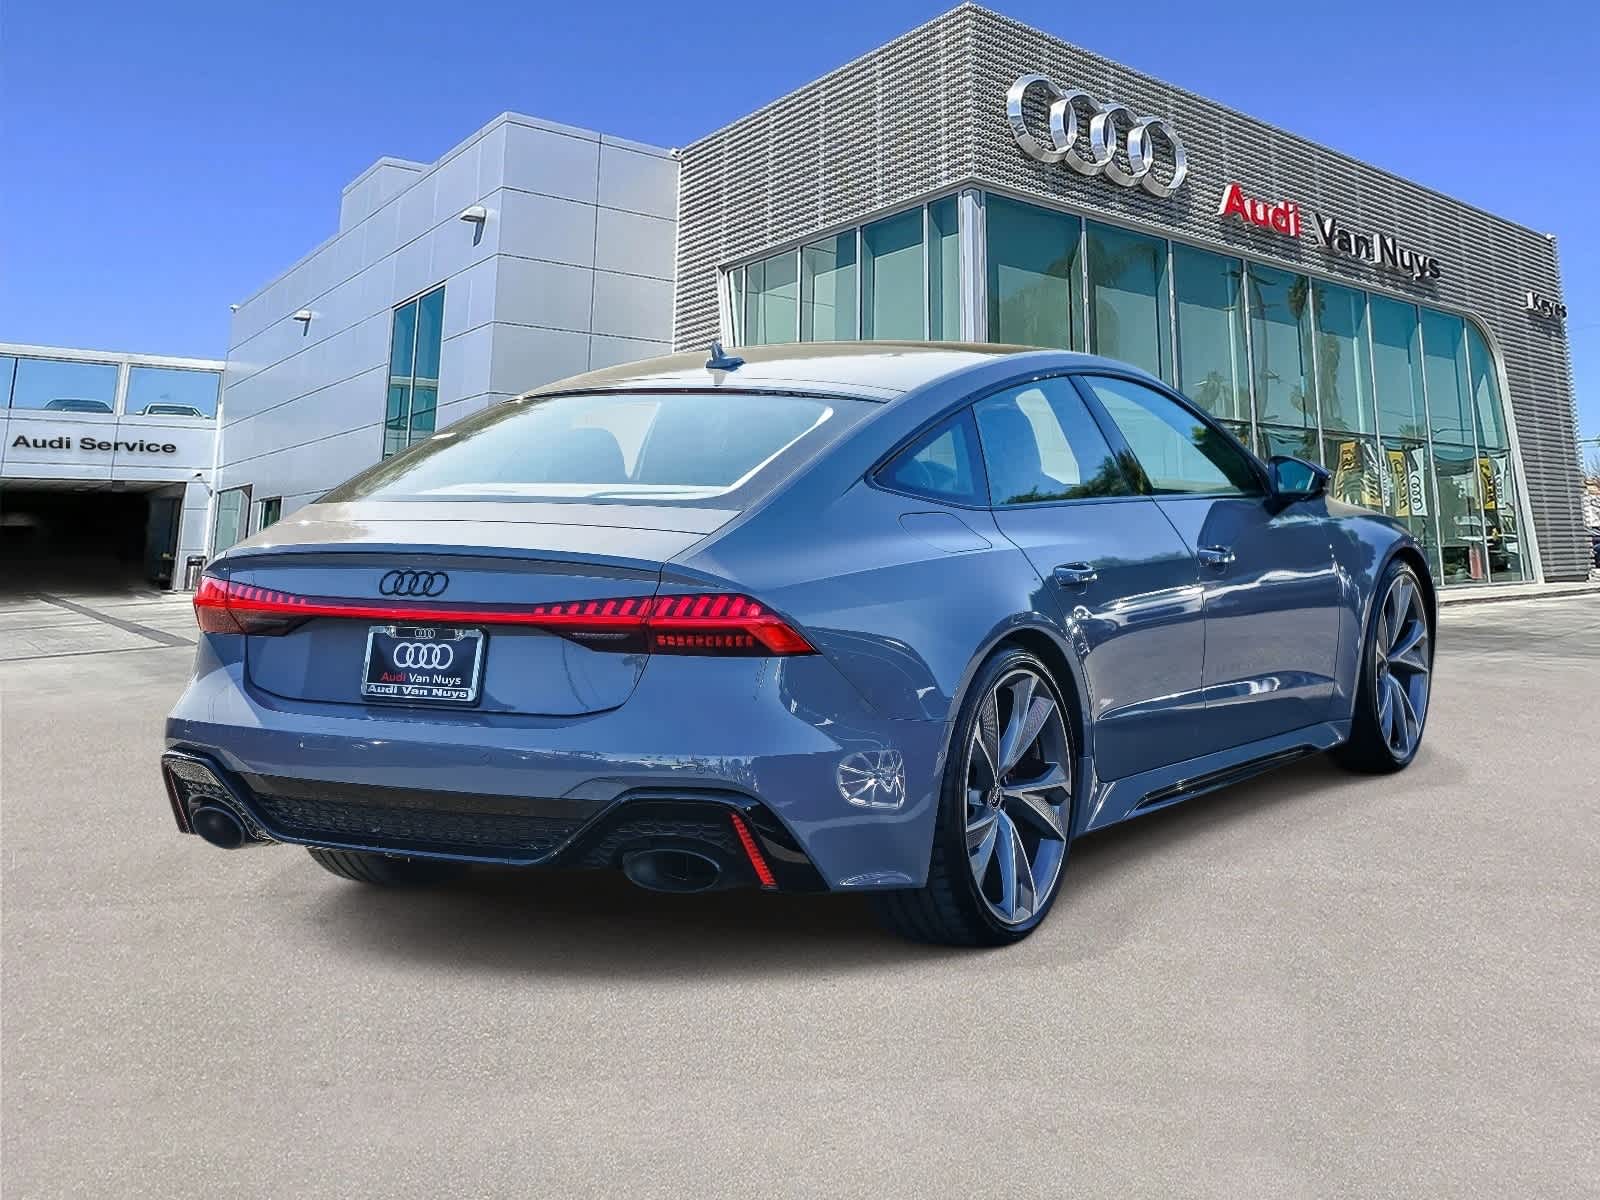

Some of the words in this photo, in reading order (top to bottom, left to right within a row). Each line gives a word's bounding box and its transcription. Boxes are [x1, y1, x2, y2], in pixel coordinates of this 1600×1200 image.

[1217, 181, 1301, 238] Audi
[1311, 210, 1373, 259] Van
[1374, 232, 1441, 282] Nuys
[12, 434, 71, 449] Audi
[79, 437, 177, 453] Service
[381, 671, 406, 682] Audi
[409, 672, 430, 684] Van
[433, 674, 462, 686] Nuys
[367, 684, 398, 694] Audi
[402, 686, 428, 696] Van
[432, 688, 468, 699] Nuys
